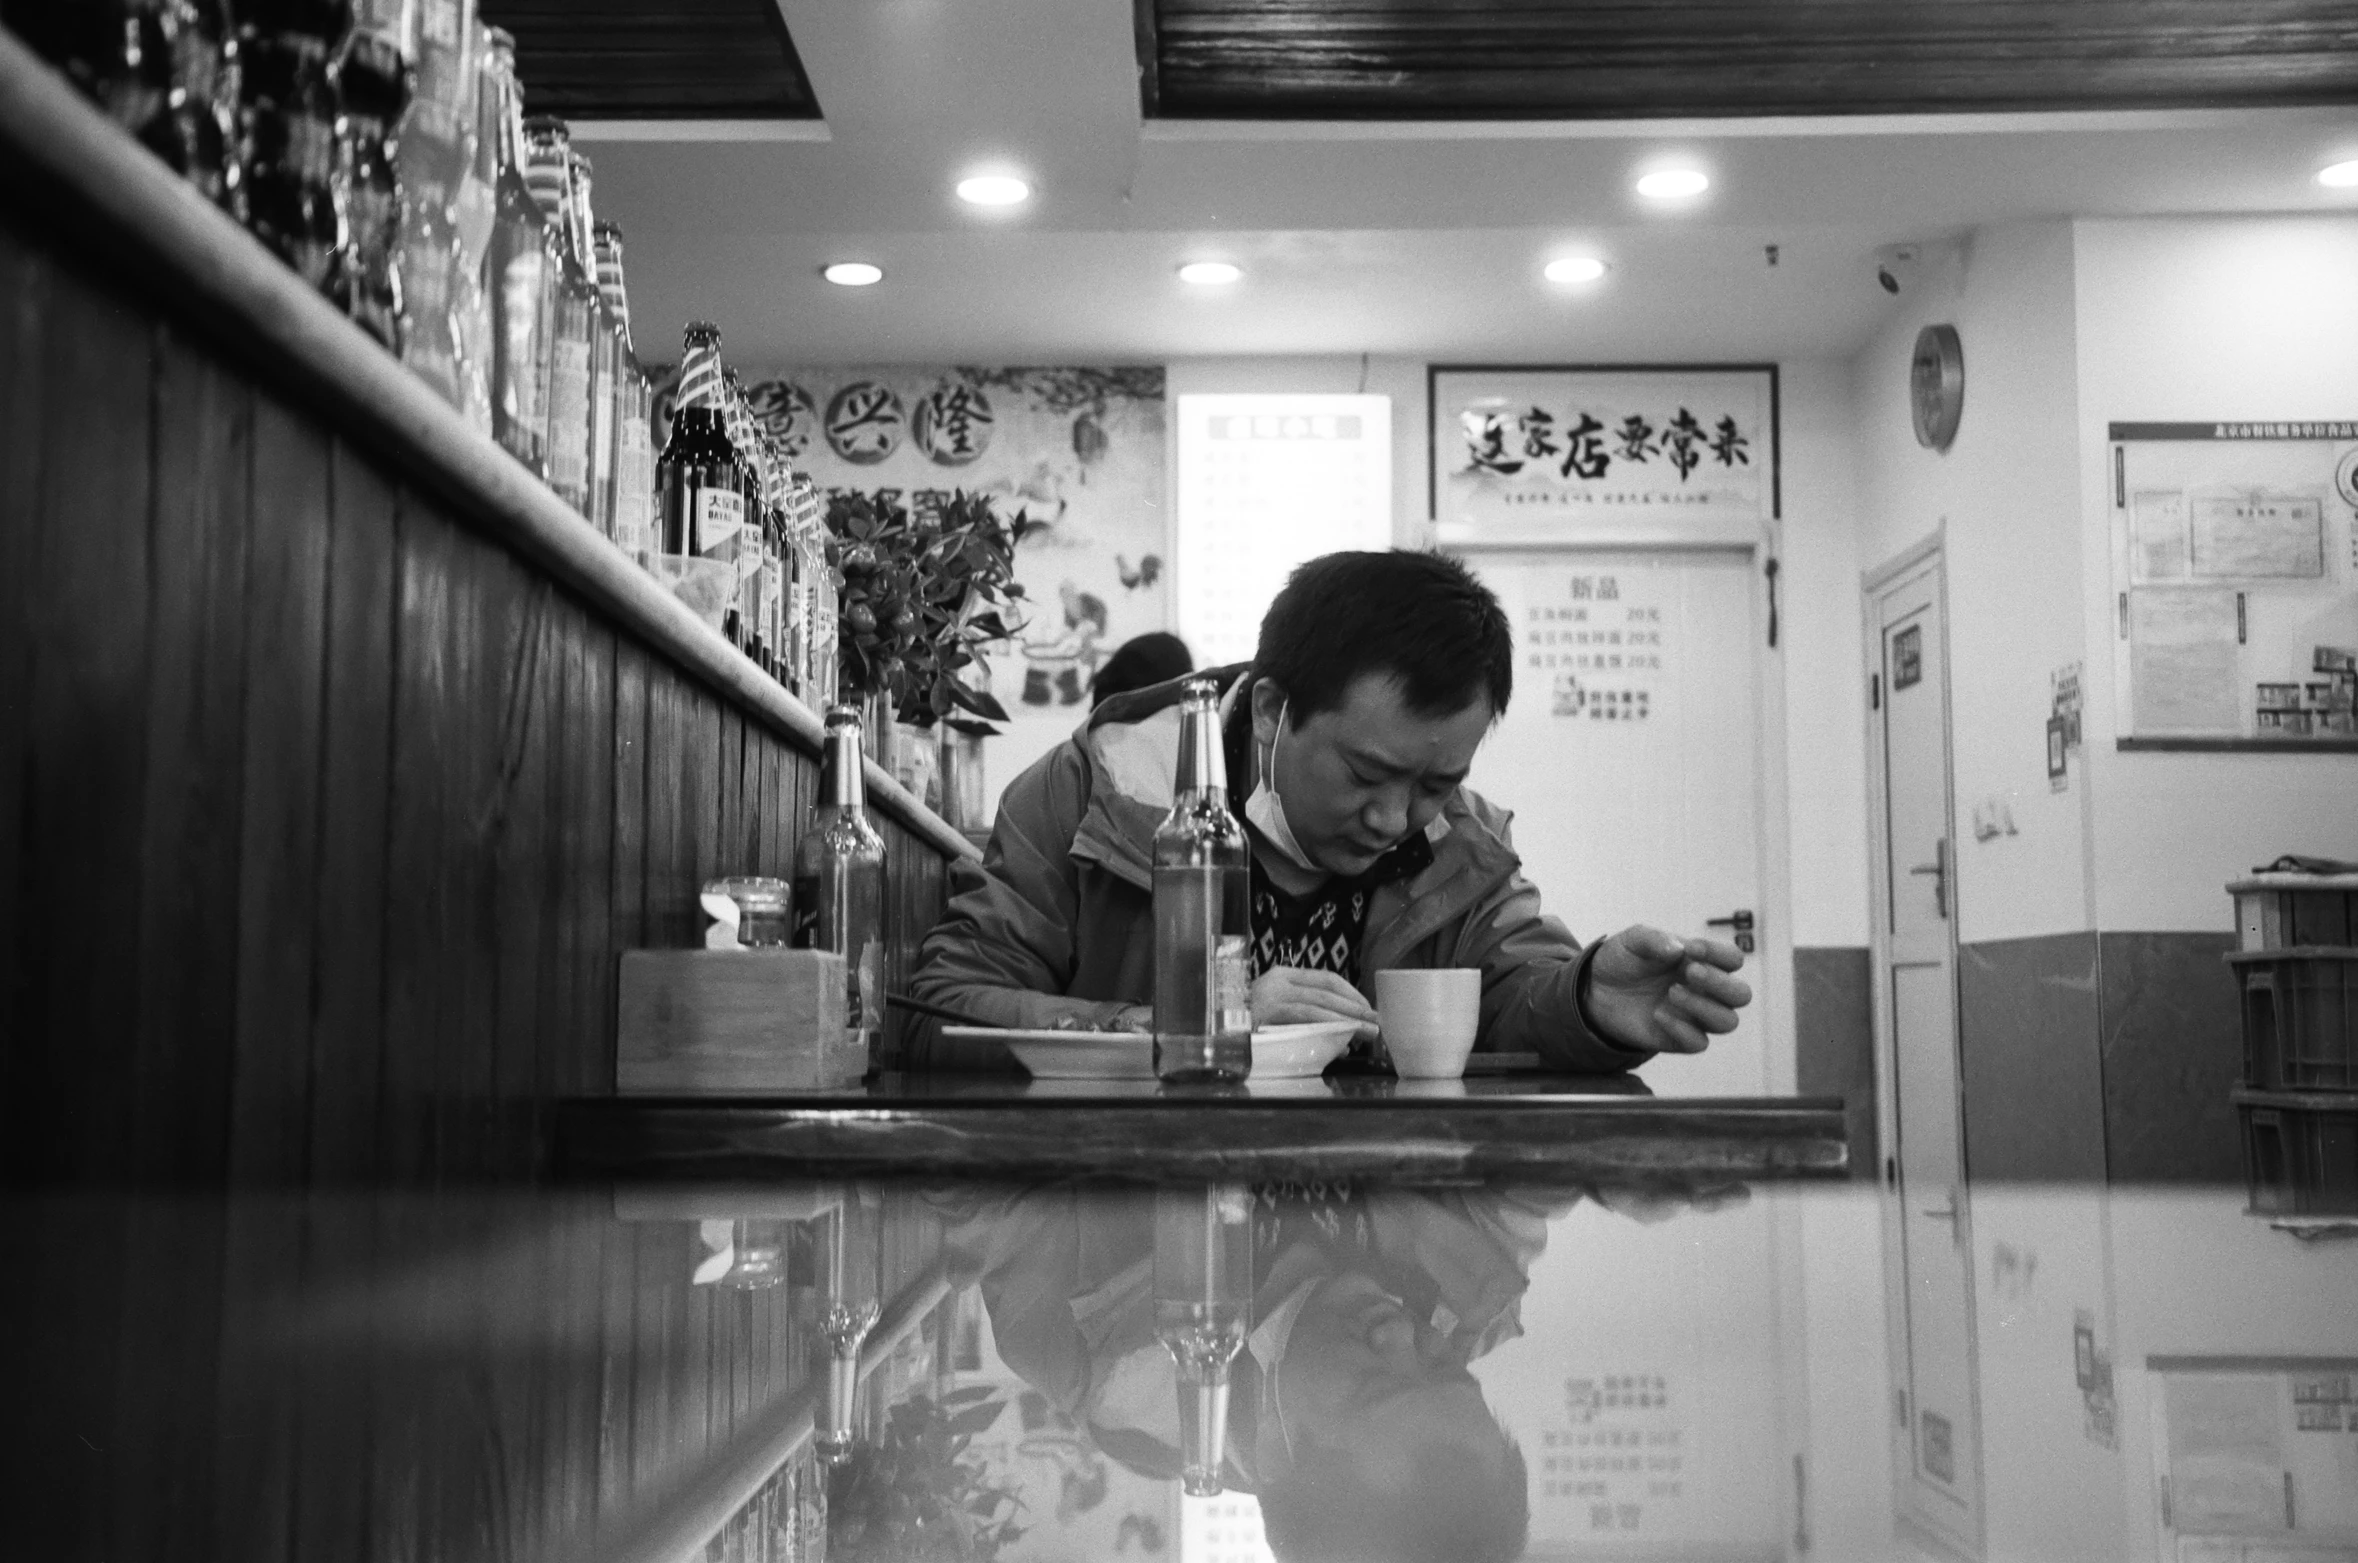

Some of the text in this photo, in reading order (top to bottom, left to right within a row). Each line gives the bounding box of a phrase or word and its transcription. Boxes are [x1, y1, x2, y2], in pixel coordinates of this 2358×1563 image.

[664, 379, 994, 459] 意兴隆
[1466, 406, 1749, 482] 这家店要常来
[1571, 576, 1619, 600] 新品
[1627, 607, 1660, 622] 20元
[1627, 631, 1660, 646] 20元
